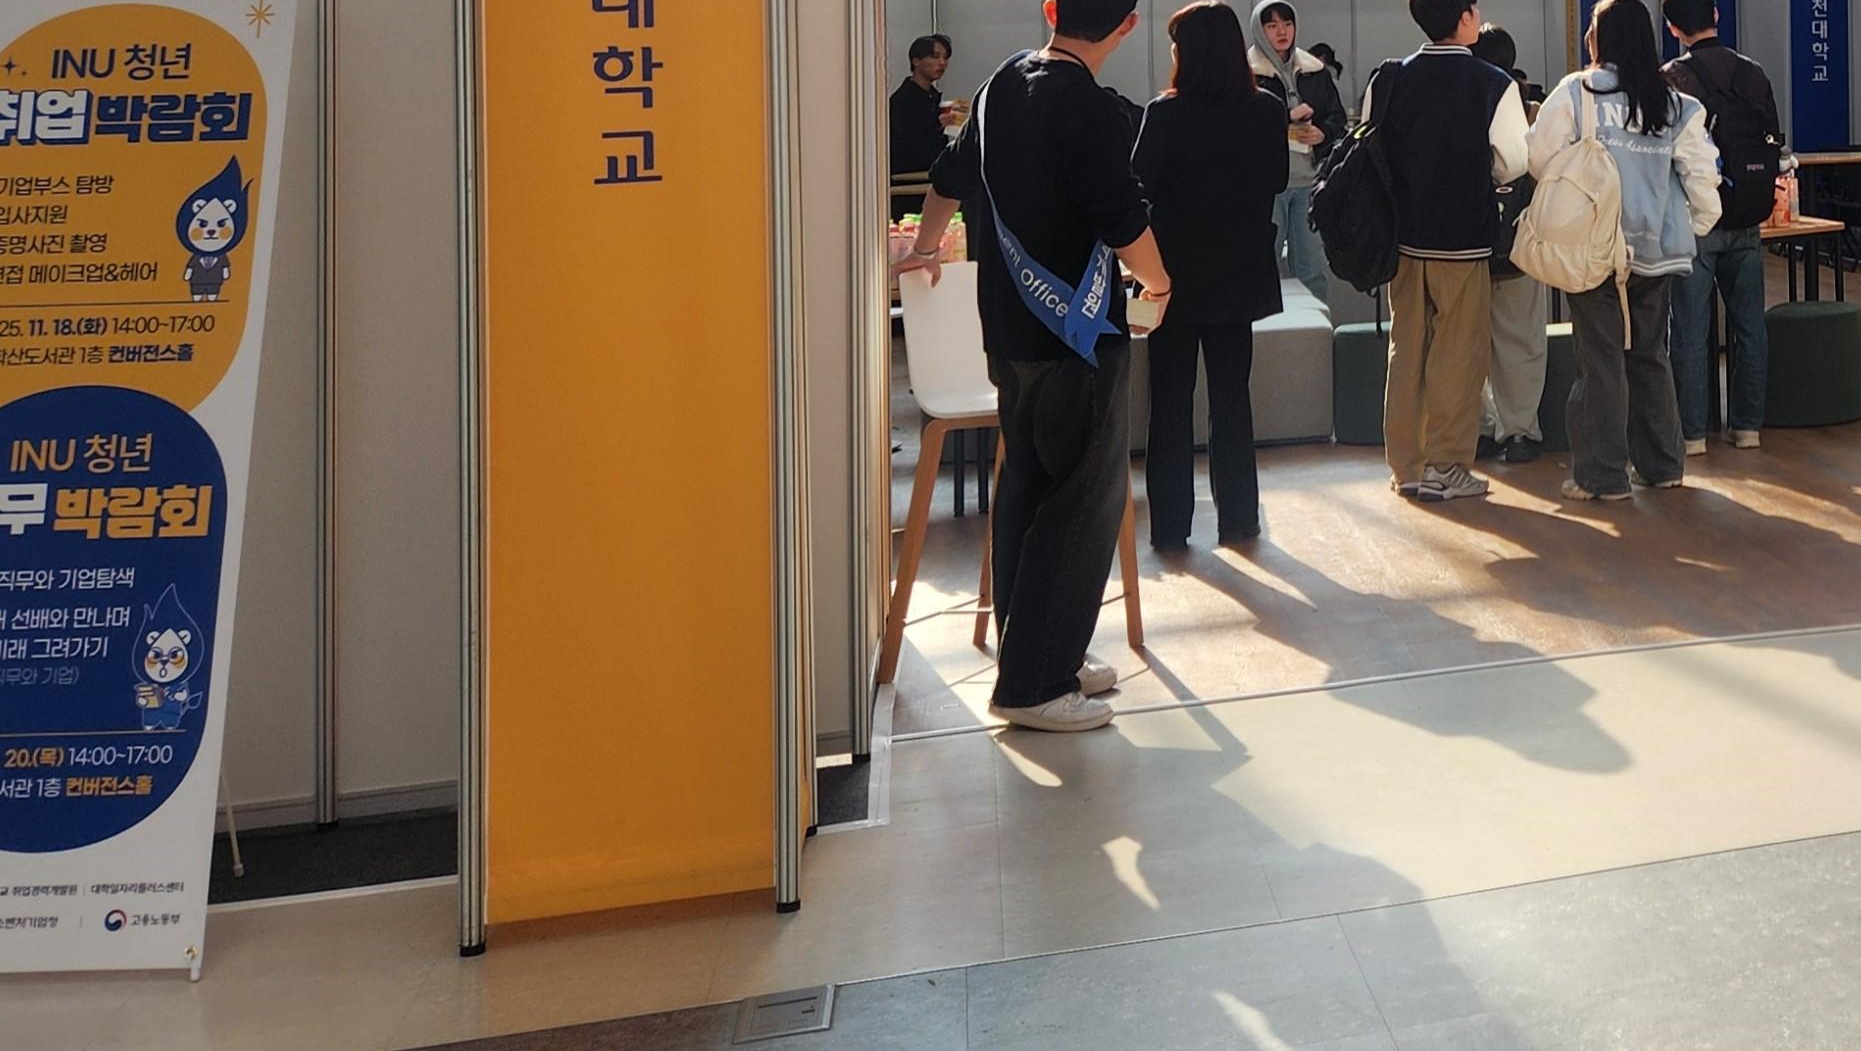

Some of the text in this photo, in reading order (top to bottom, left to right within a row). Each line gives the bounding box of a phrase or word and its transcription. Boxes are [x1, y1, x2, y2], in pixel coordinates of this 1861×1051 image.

[51, 43, 192, 81] INU 청년
[95, 92, 252, 143] 박람회
[76, 175, 114, 195] 탐방
[70, 233, 108, 254] 촬영
[29, 262, 158, 284] 메이크업&헤어
[1020, 268, 1069, 317] Office
[29, 319, 48, 337] 11.
[113, 315, 216, 334] 14:00~17:00
[80, 343, 194, 364] 1층 컨버전스홀
[10, 432, 153, 473] INU 청년
[53, 484, 213, 540] 박람회
[59, 567, 136, 590] 기업탐색
[12, 607, 69, 631] 선배와
[73, 606, 131, 630] 만나며
[31, 637, 109, 659] 그려가기
[41, 666, 80, 686] 기업)
[69, 744, 174, 766] 14:00~17:00
[37, 775, 153, 798] 1층 컨버전스홀
